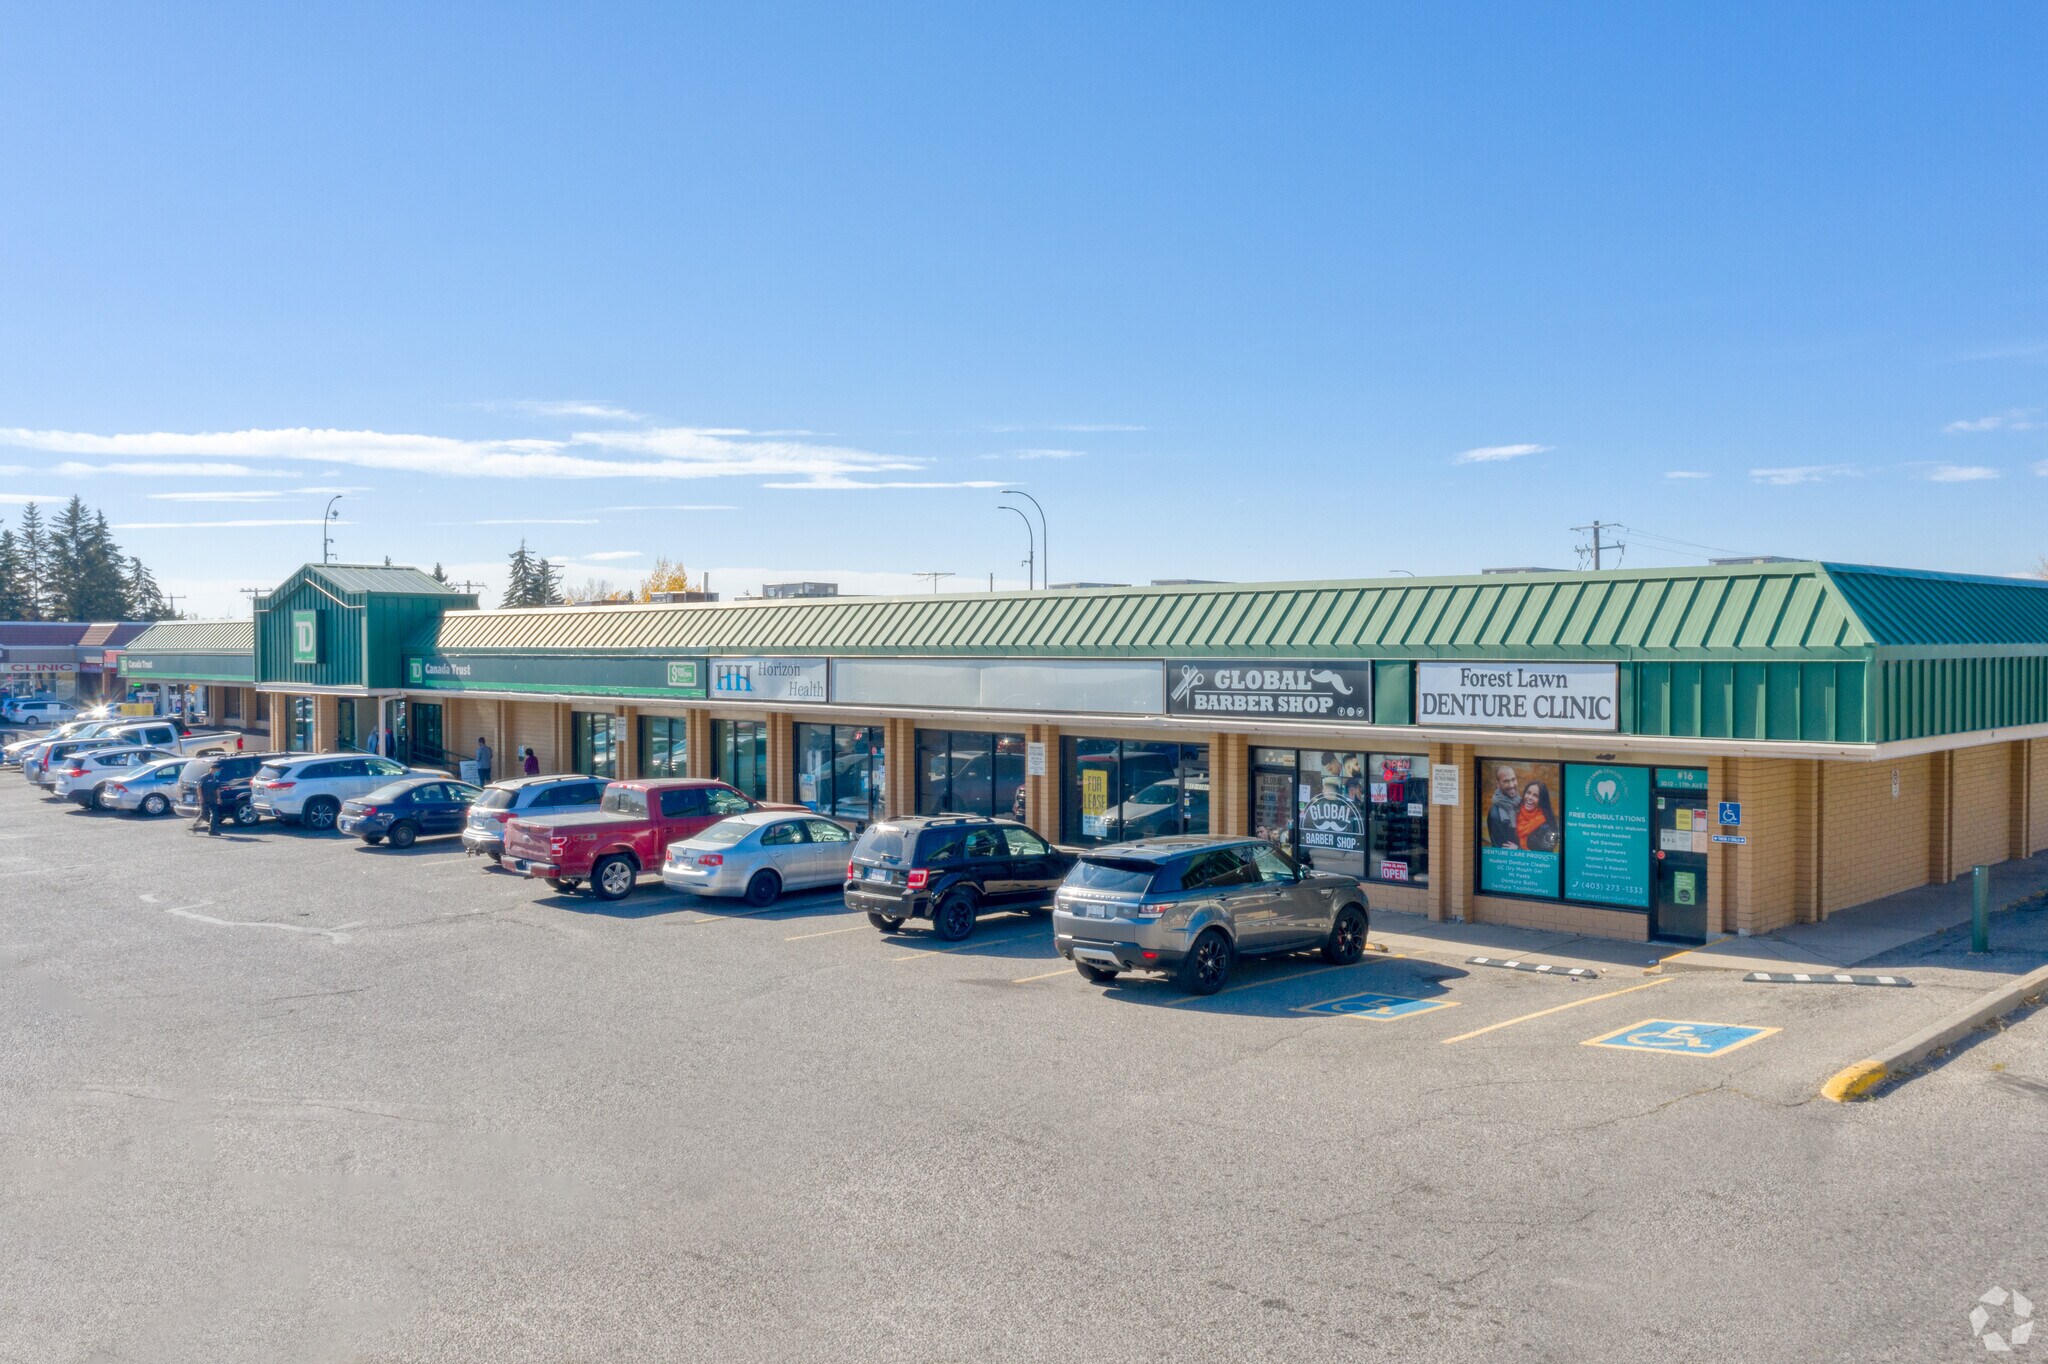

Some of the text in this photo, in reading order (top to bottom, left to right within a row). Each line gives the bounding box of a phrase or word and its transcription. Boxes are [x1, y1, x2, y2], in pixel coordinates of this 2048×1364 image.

[296, 621, 313, 652] TD
[11, 663, 73, 672] CLINIC
[128, 660, 142, 669] Canada
[142, 660, 153, 669] Trust
[411, 663, 471, 678] TD Canada Trust
[758, 661, 801, 677] Horizon
[1214, 670, 1312, 690] GLOBAL
[1460, 668, 1568, 688] Forest Lawn
[789, 681, 824, 697] Health
[1194, 694, 1333, 713] BARBER SHOP
[1422, 693, 1611, 720] DENTURE CLINIC
[1382, 760, 1410, 771] OPEN
[1677, 772, 1693, 780] #16
[1087, 776, 1102, 793] FOR
[1084, 794, 1106, 811] LEASE
[1310, 803, 1351, 824] GLOBAL
[1568, 811, 1646, 823] FREE CONSULTATIONS
[1305, 833, 1356, 849] BARBER SHOP
[1483, 849, 1509, 857] DENTURE
[1526, 853, 1557, 861] PRODUCTS
[1383, 867, 1406, 880] OPEN
[1581, 871, 1609, 879] Emergency
[1513, 884, 1548, 894] Toothbrushes
[1581, 882, 1603, 891] (403)
